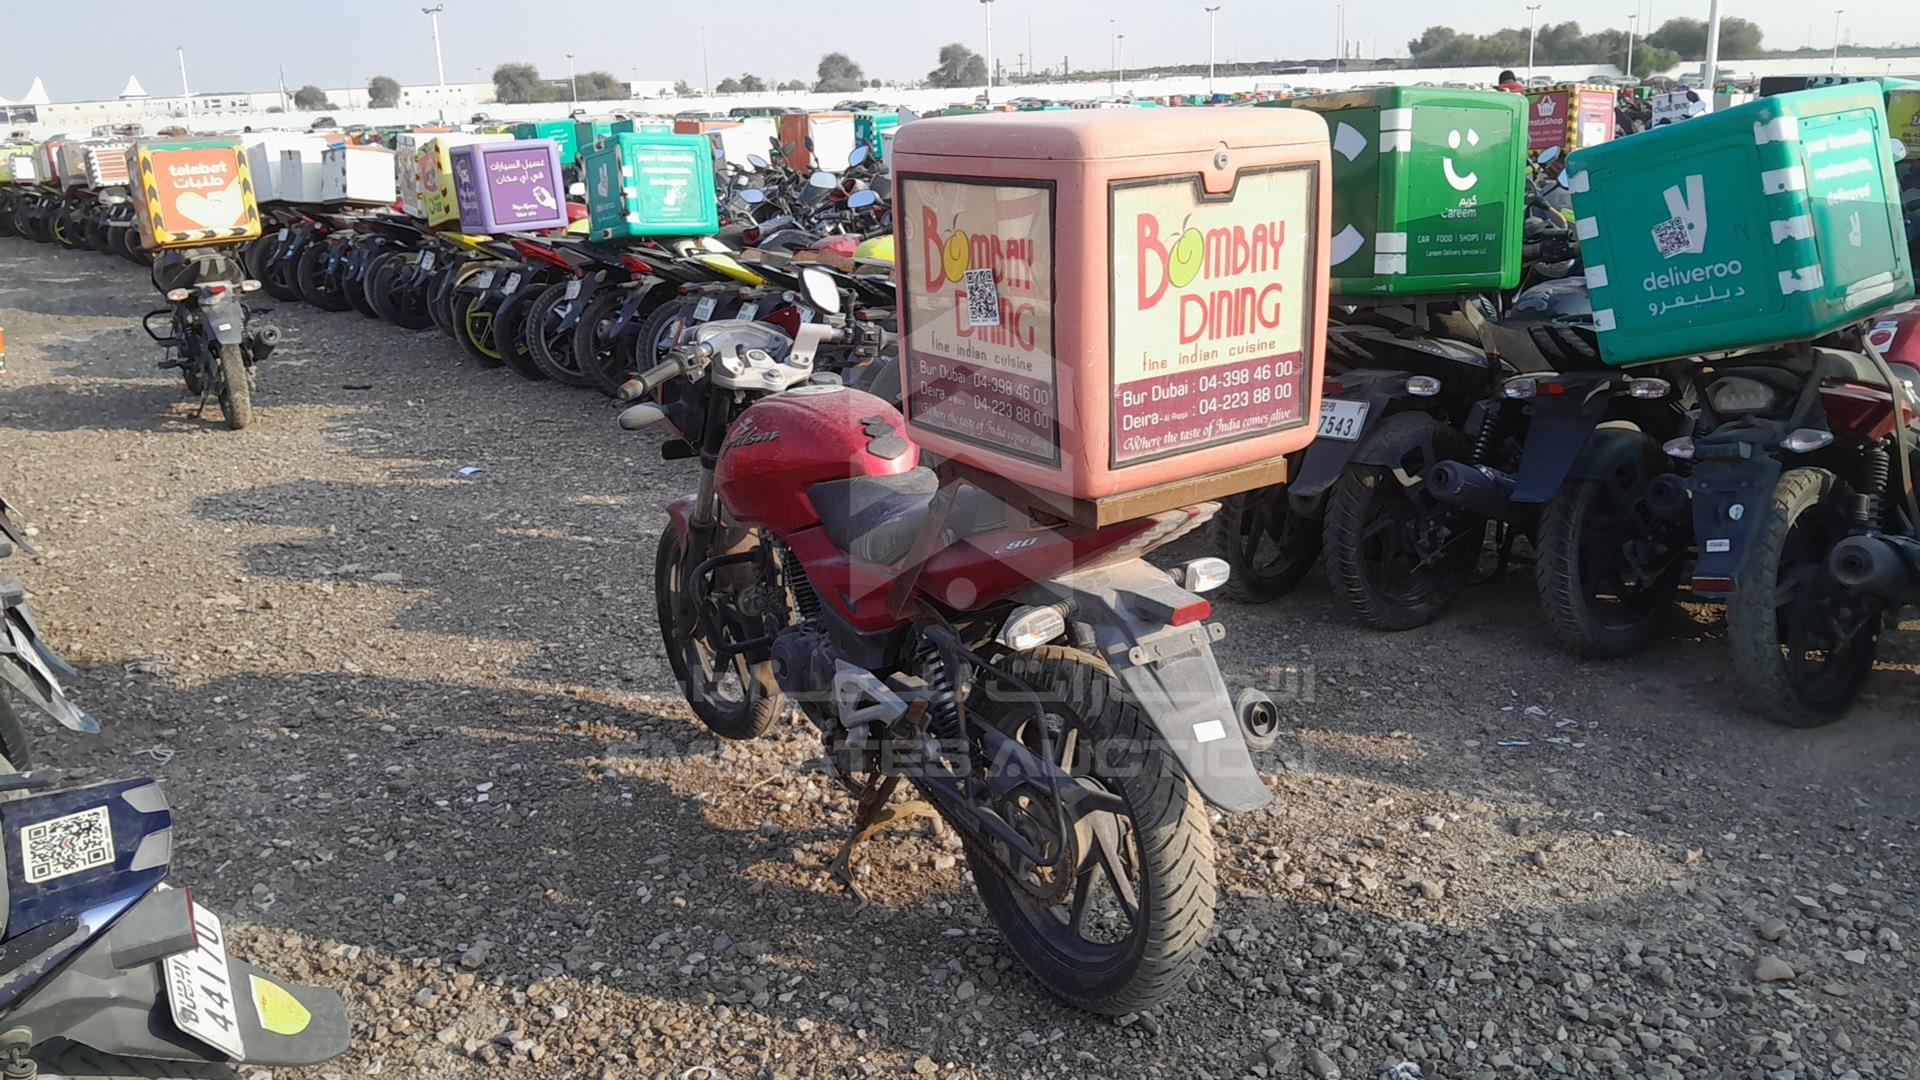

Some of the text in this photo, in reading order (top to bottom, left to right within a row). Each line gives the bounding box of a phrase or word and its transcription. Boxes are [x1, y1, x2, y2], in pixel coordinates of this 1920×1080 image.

[168, 161, 228, 177] talabat
[489, 159, 546, 172] غسيل السيارات
[496, 173, 518, 185] مكان
[530, 171, 544, 182] في
[173, 175, 225, 189] طلبات
[1440, 207, 1477, 219] Careem
[1458, 194, 1478, 208] كريم
[1417, 232, 1496, 243] CAR FOOD SHOPS PAY
[1137, 213, 1285, 311] BOMBAY
[1643, 260, 1742, 291] deliveroo
[1179, 283, 1282, 345] DINING
[1648, 285, 1745, 316] ديليفرو
[931, 331, 1033, 372] fine indian cuisine
[1142, 339, 1276, 372] fine indian cuisine
[919, 360, 937, 377] Bur
[939, 364, 966, 384] Dubai
[973, 373, 1012, 396] 04-398
[1016, 383, 1030, 401] 46
[1034, 388, 1049, 406] 00
[1122, 390, 1148, 408] Bur
[1151, 379, 1189, 401] Dubai
[1199, 368, 1249, 392] 04-398
[1253, 363, 1271, 381] 46
[1275, 360, 1293, 378] 00
[1199, 391, 1249, 415] 04-223
[1252, 386, 1271, 405] 88
[1274, 382, 1292, 400] 00
[973, 395, 1012, 417] 04-223
[1015, 405, 1030, 424] 88
[1034, 411, 1049, 429] 00
[1123, 407, 1291, 451] Where the taste of India comes alive
